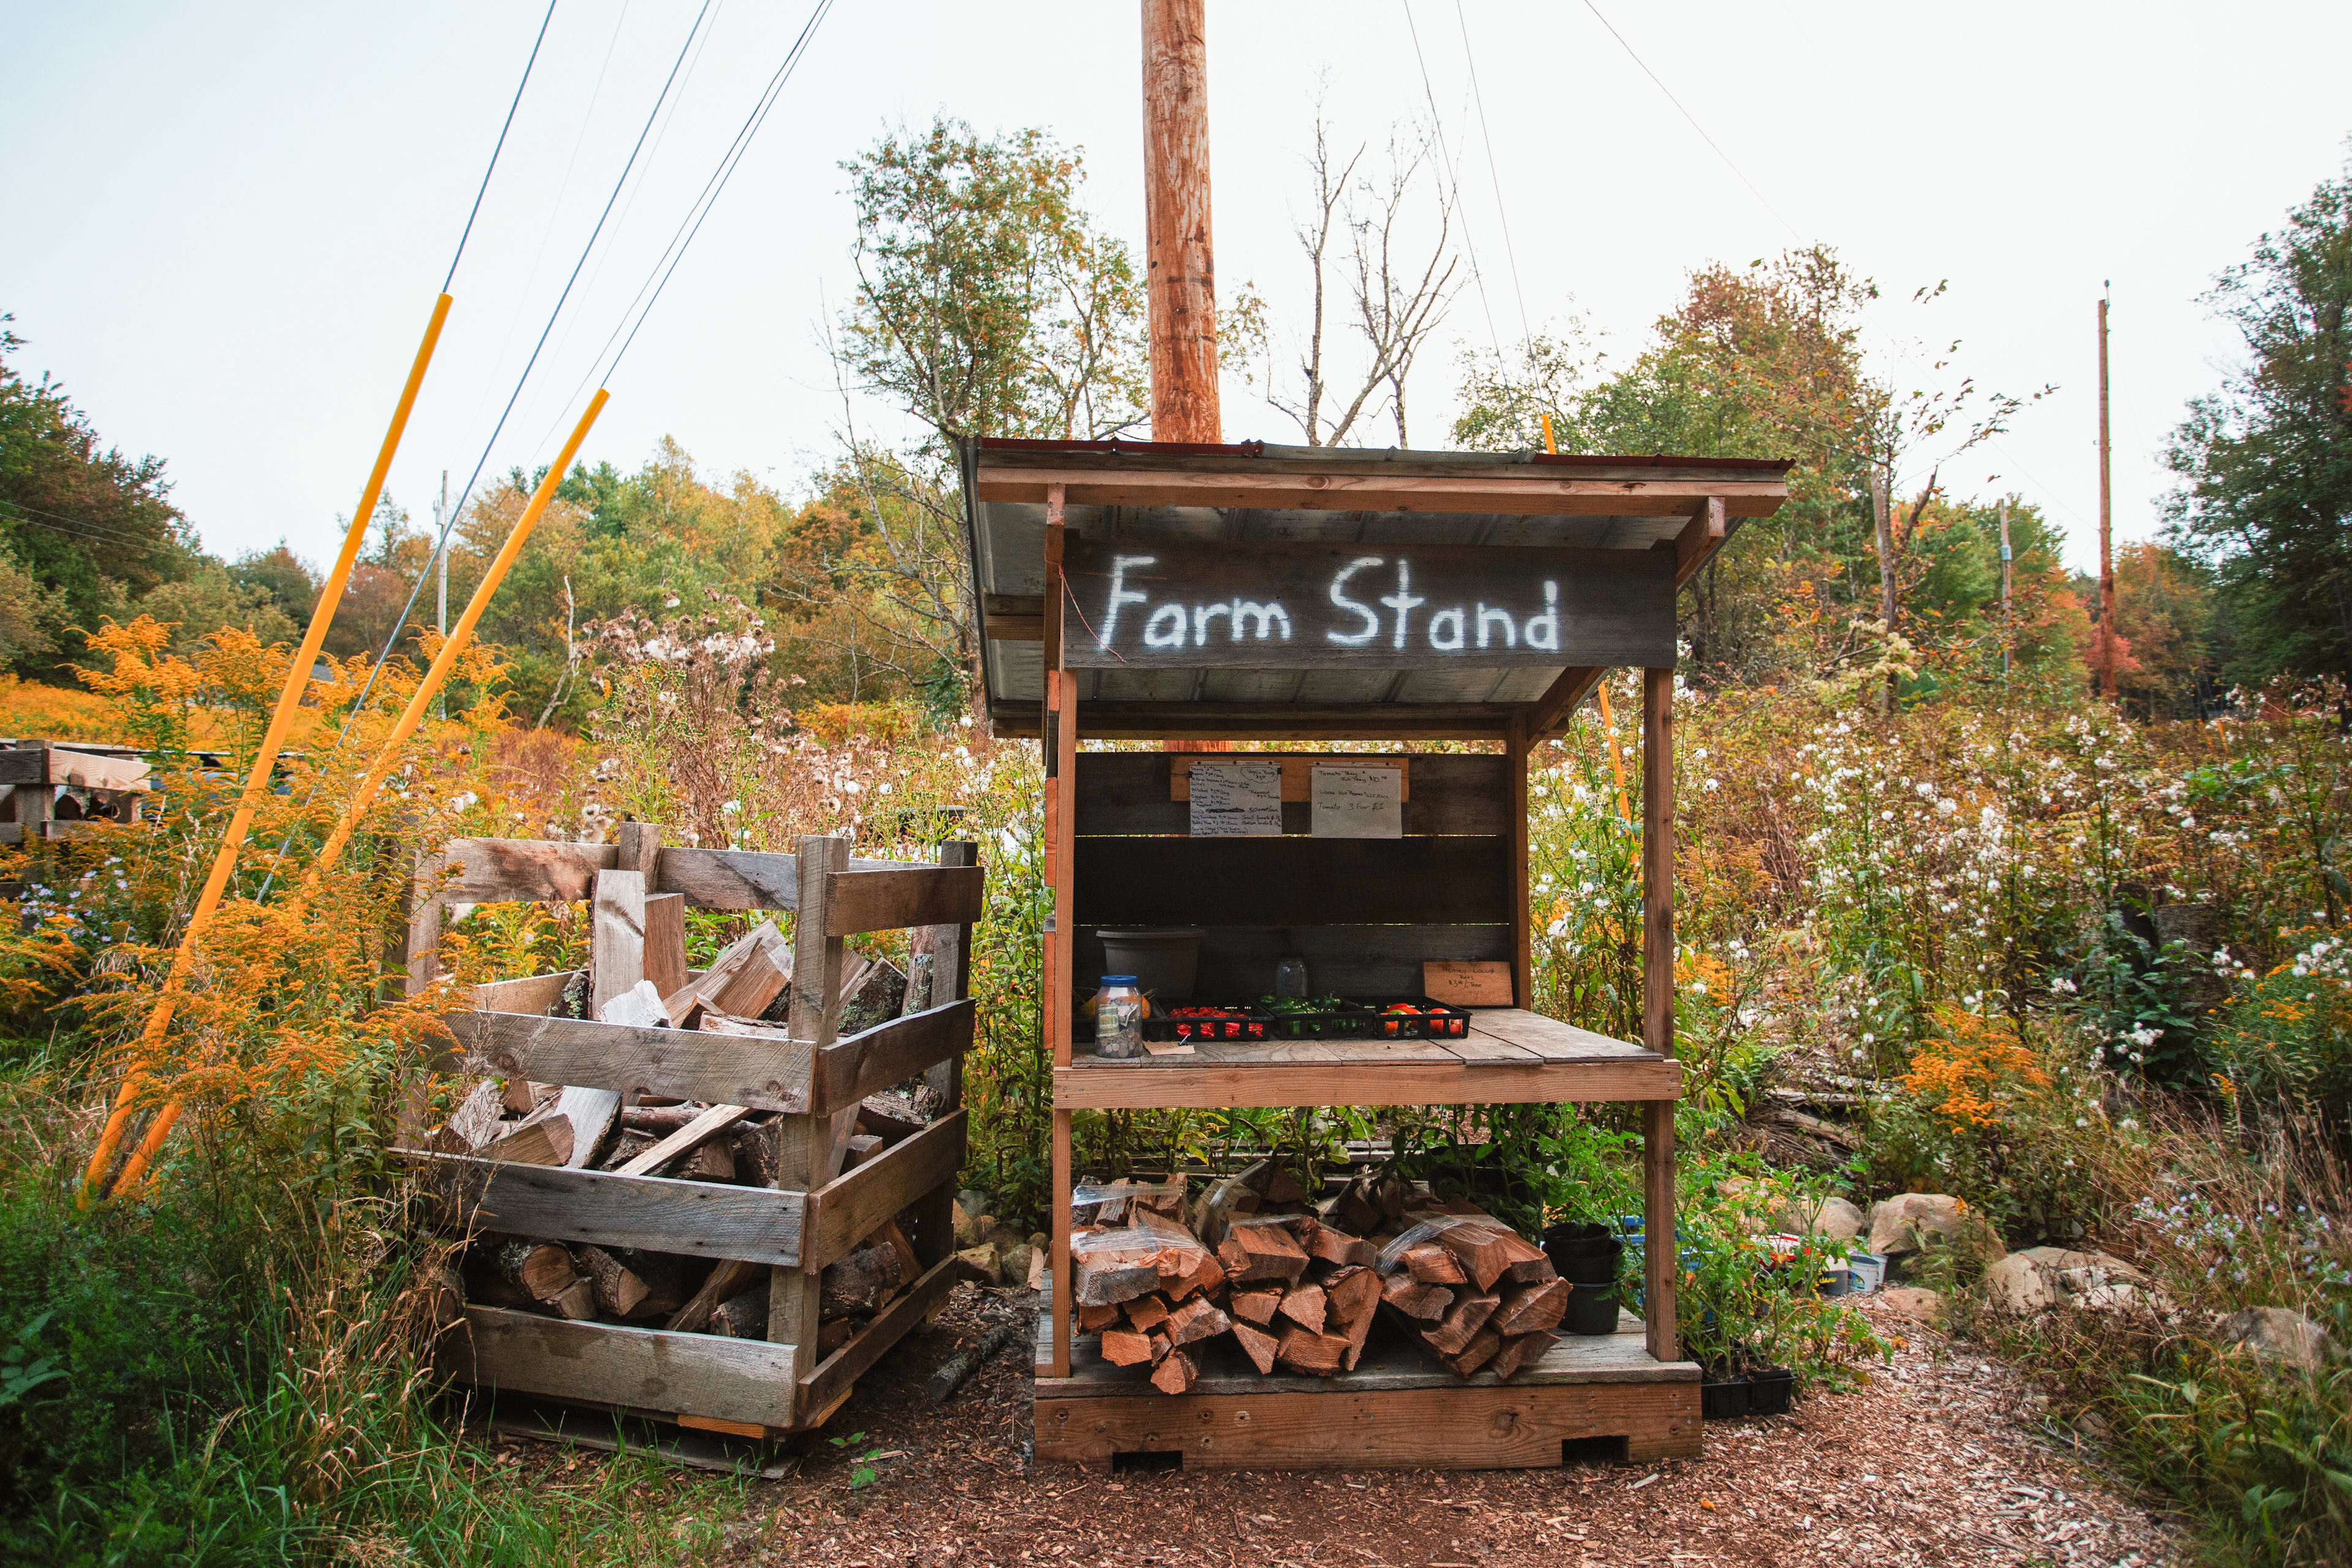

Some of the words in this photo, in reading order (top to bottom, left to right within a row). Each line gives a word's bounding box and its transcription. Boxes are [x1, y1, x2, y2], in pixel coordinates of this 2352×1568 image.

[1099, 556, 1292, 651] Farm
[1326, 557, 1559, 651] Stand
[1372, 802, 1384, 812] $1
